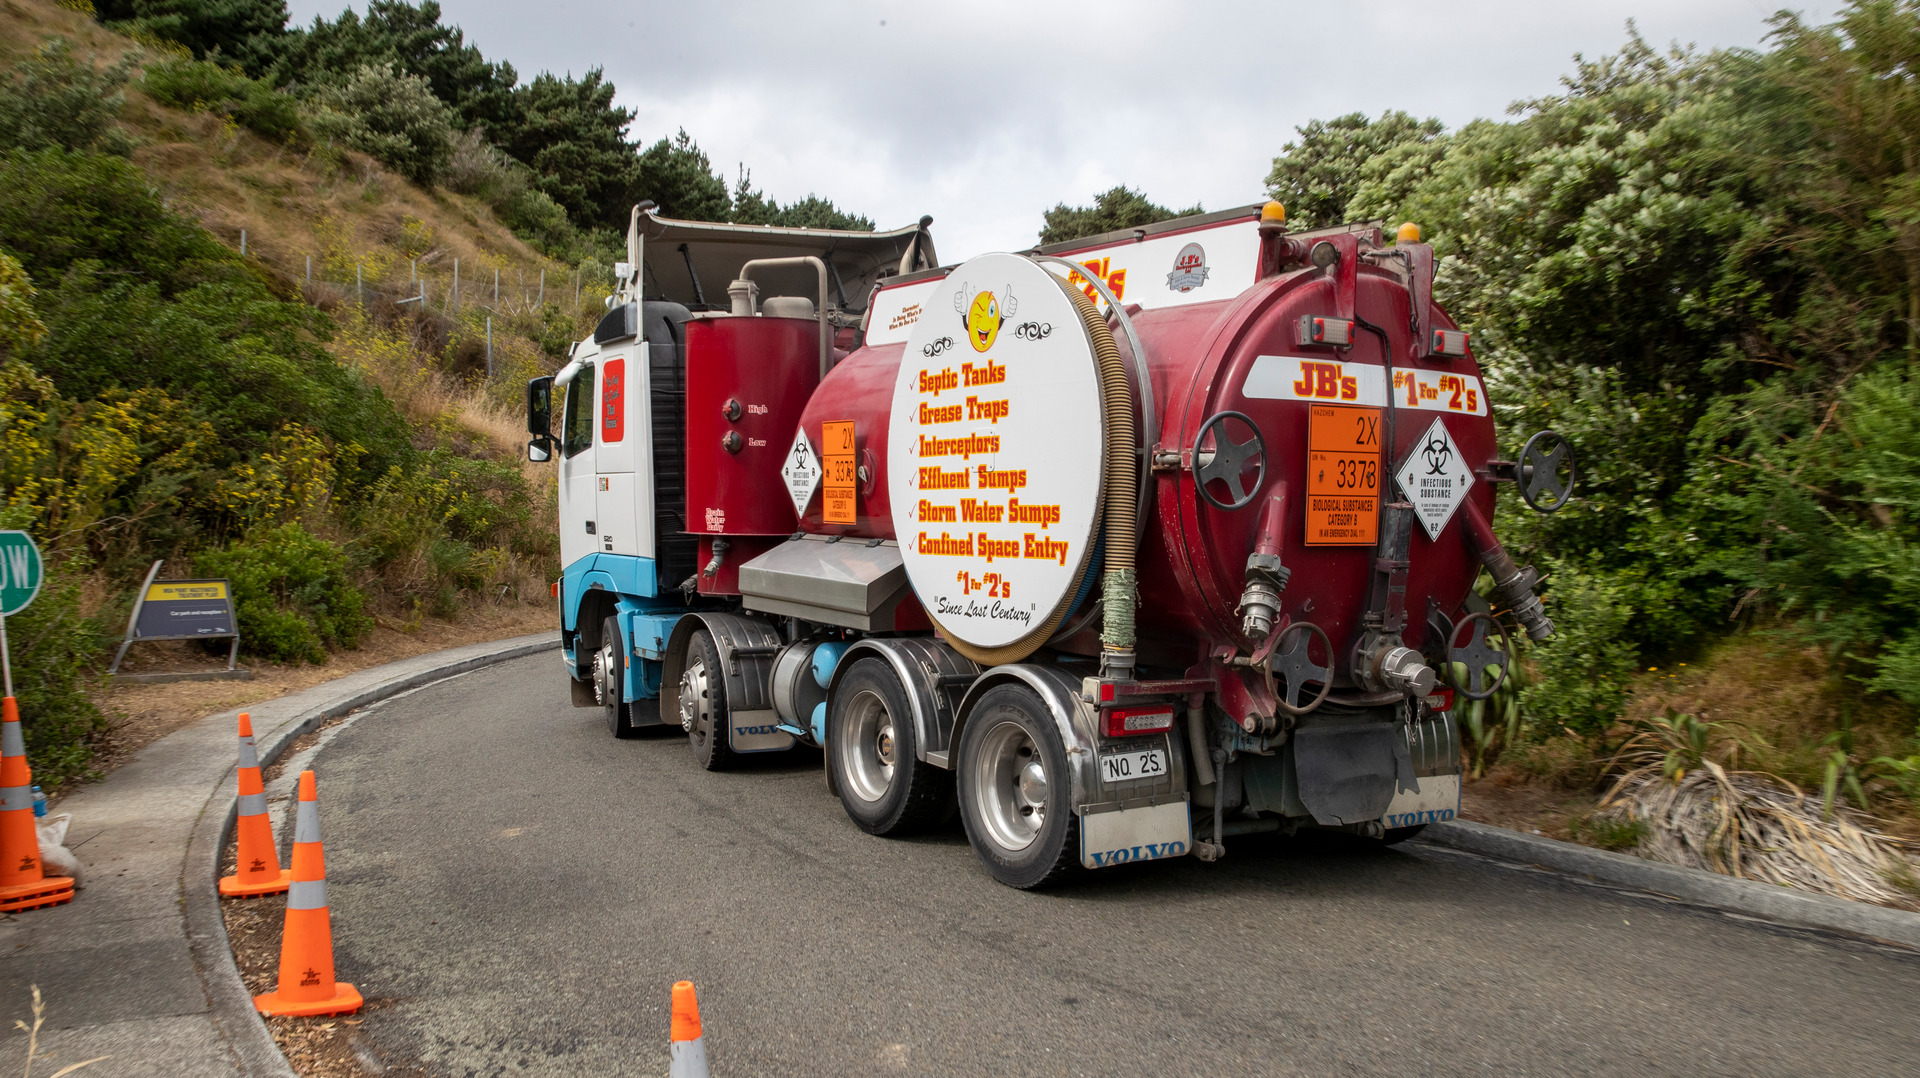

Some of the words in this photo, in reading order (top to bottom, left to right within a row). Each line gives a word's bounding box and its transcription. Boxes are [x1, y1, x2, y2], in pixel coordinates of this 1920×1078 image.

[918, 367, 958, 397] Septic
[961, 358, 1006, 388] Tanks
[1293, 361, 1358, 401] JB's
[1393, 370, 1419, 407] #1
[1418, 382, 1439, 400] For
[1439, 374, 1478, 413] #2's
[748, 404, 768, 415] High
[918, 401, 963, 426] Grease
[966, 395, 1009, 424] Traps
[1313, 409, 1335, 417] HAZCHEM
[843, 427, 853, 449] 2X
[1356, 416, 1378, 446] 2X
[748, 437, 766, 446] Low
[918, 432, 1000, 461] Interceptors
[918, 466, 970, 490] Effluent
[978, 464, 1027, 494] Sumps
[1420, 478, 1452, 488] INFECTIOUS
[1420, 488, 1451, 498] SUBSTANCE
[706, 507, 724, 516] Drain
[918, 499, 957, 523] Storm
[960, 497, 1004, 523] Water
[1008, 497, 1061, 529] Sumps
[1312, 498, 1341, 512] BIOLOGICAL
[1342, 499, 1373, 512] SUBSTANCES
[705, 515, 725, 524] Water
[706, 523, 724, 533] Daily
[1327, 513, 1353, 526] CATEGORY
[1353, 514, 1358, 526] B
[1329, 529, 1349, 538] EMERGENCY
[1350, 529, 1358, 538] DIAL
[918, 531, 974, 557] Confined
[977, 532, 1020, 563] Space
[1023, 533, 1069, 566] Entry
[957, 570, 970, 595] #1
[970, 578, 982, 591] For
[983, 572, 1011, 599] #2's
[934, 596, 963, 616] "Since
[964, 600, 988, 618] Last
[990, 600, 1036, 627] Century"
[735, 725, 778, 736] VOLV
[1387, 808, 1455, 828] VOLVO
[1090, 841, 1186, 868] VOLVO
